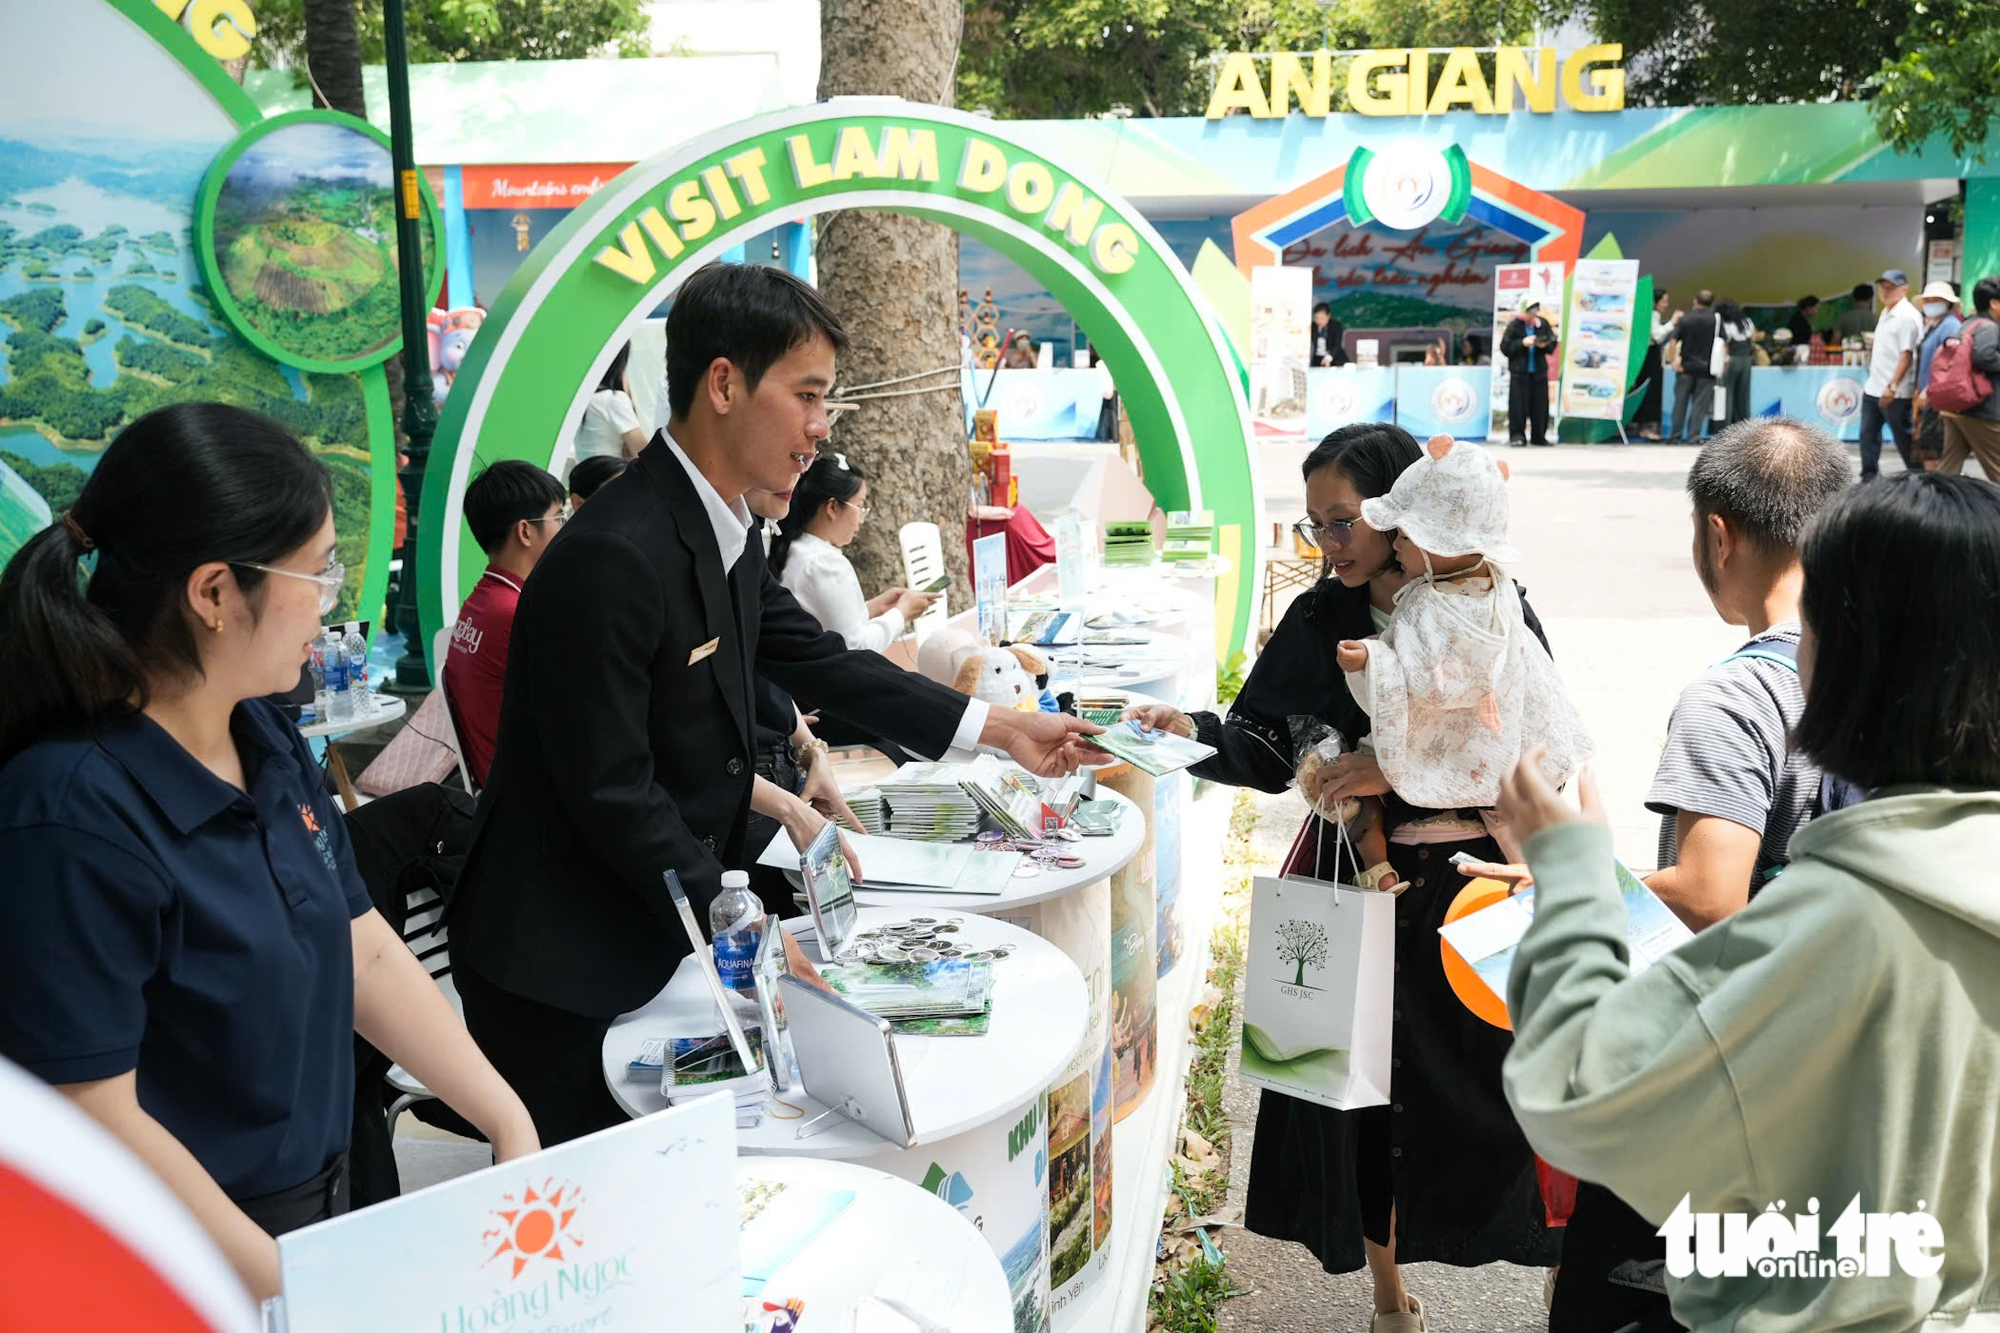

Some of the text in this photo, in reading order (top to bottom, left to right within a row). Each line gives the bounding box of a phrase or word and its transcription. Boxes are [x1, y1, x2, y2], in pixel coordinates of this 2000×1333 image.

[151, 0, 257, 61] G
[1205, 43, 1626, 120] AN GIANG
[491, 176, 606, 198] Mountains emb
[592, 125, 1141, 285] VISIT LAM DONG
[717, 957, 754, 969] AQUAFINA
[1280, 985, 1315, 1001] GHS JSC
[1008, 1103, 1037, 1163] KHU
